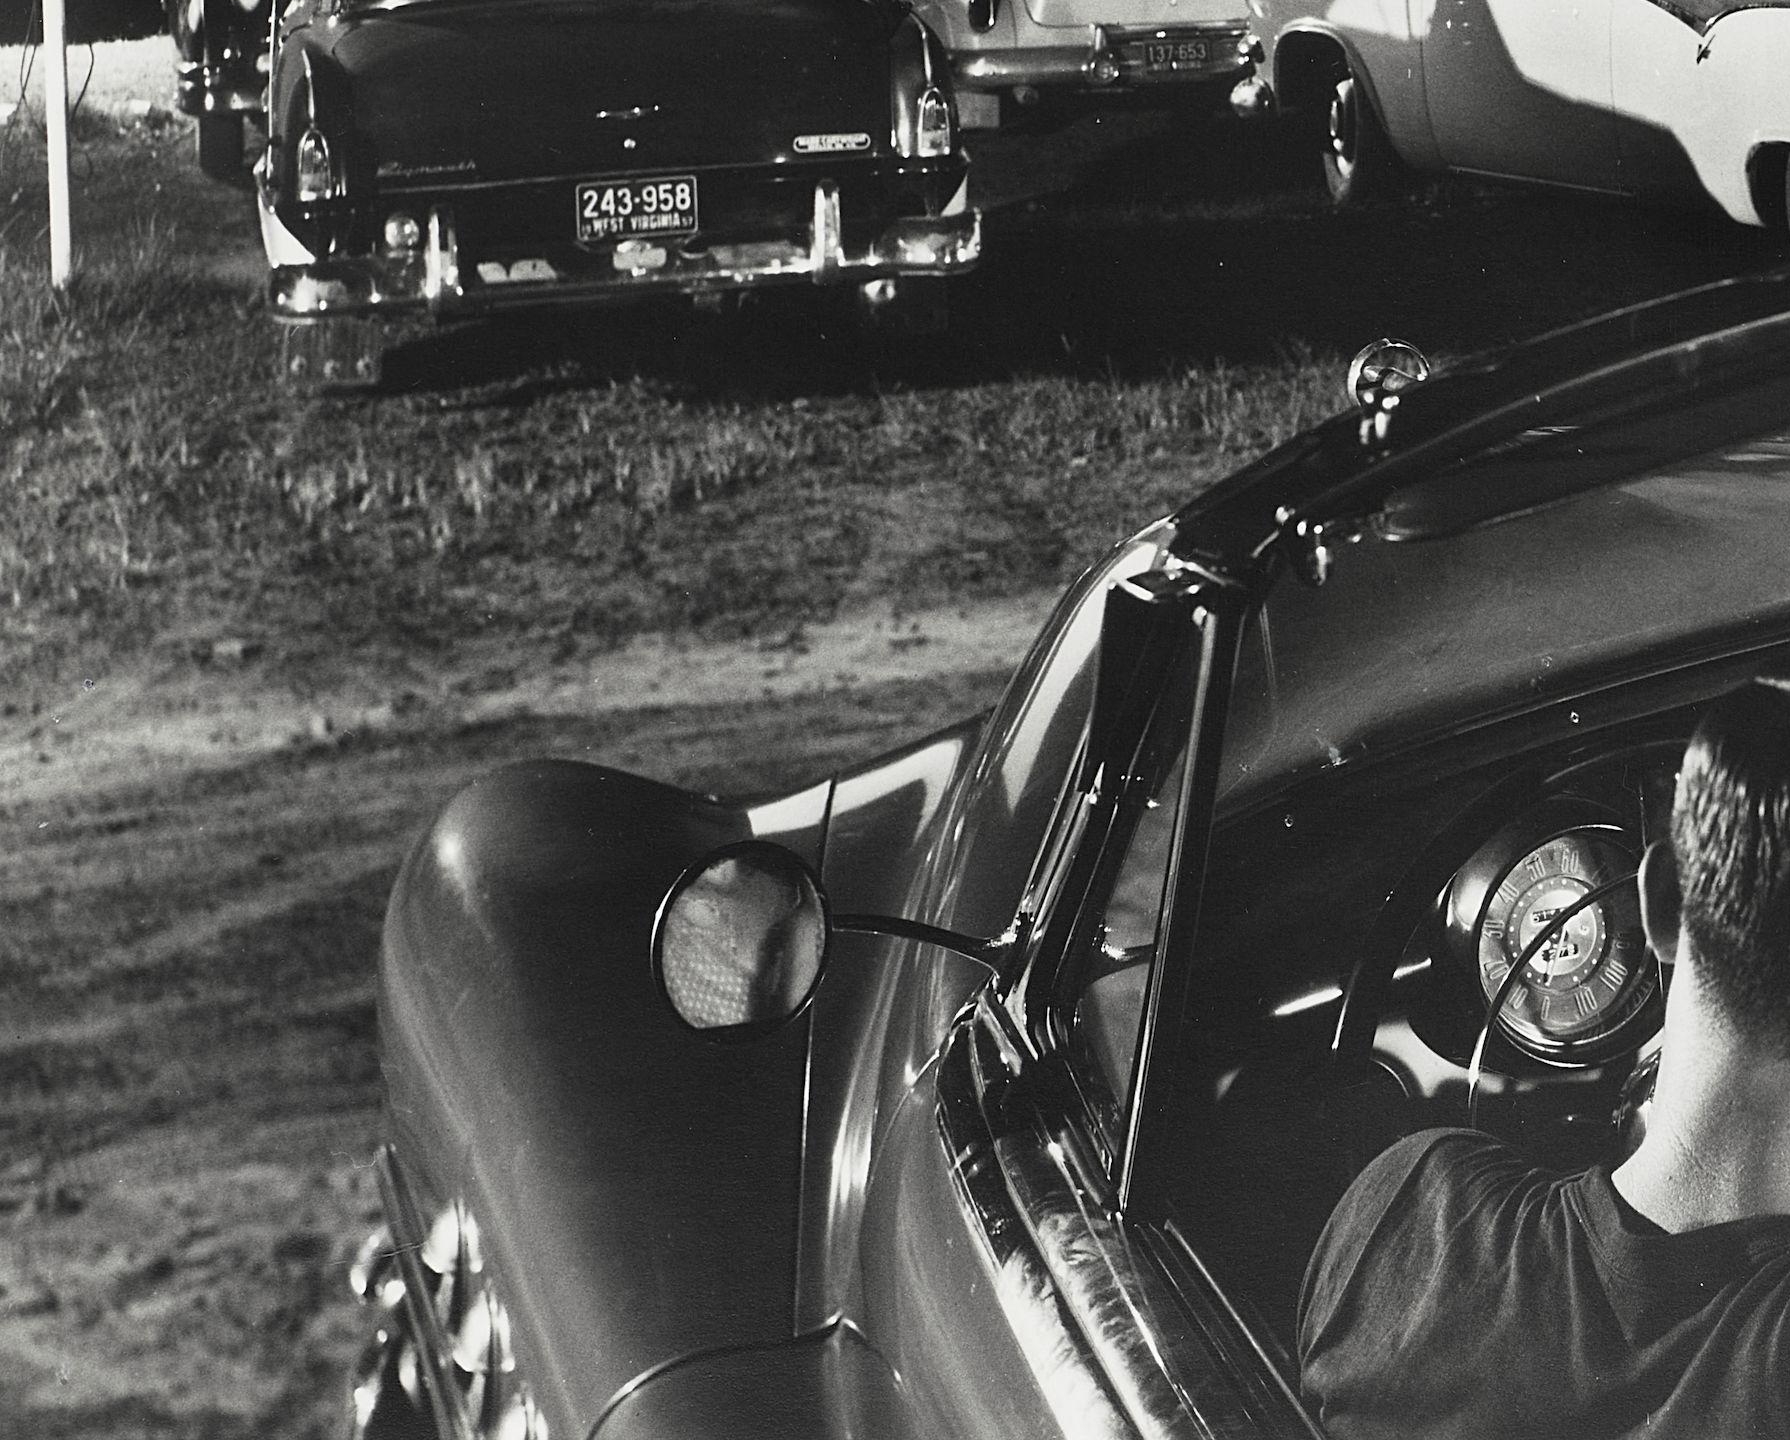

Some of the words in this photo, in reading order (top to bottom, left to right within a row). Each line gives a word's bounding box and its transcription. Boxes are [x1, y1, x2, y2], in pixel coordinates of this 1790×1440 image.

[592, 216, 624, 233] WEST
[630, 212, 681, 231] VIRGINIA
[1525, 852, 1546, 882] 50
[1561, 848, 1579, 873] 60
[1497, 881, 1520, 905] 40
[1482, 919, 1504, 939] 30
[1600, 960, 1628, 992] 100
[1508, 985, 1528, 1010] 10
[1540, 995, 1550, 1021] 0
[1574, 986, 1598, 1017] 110
